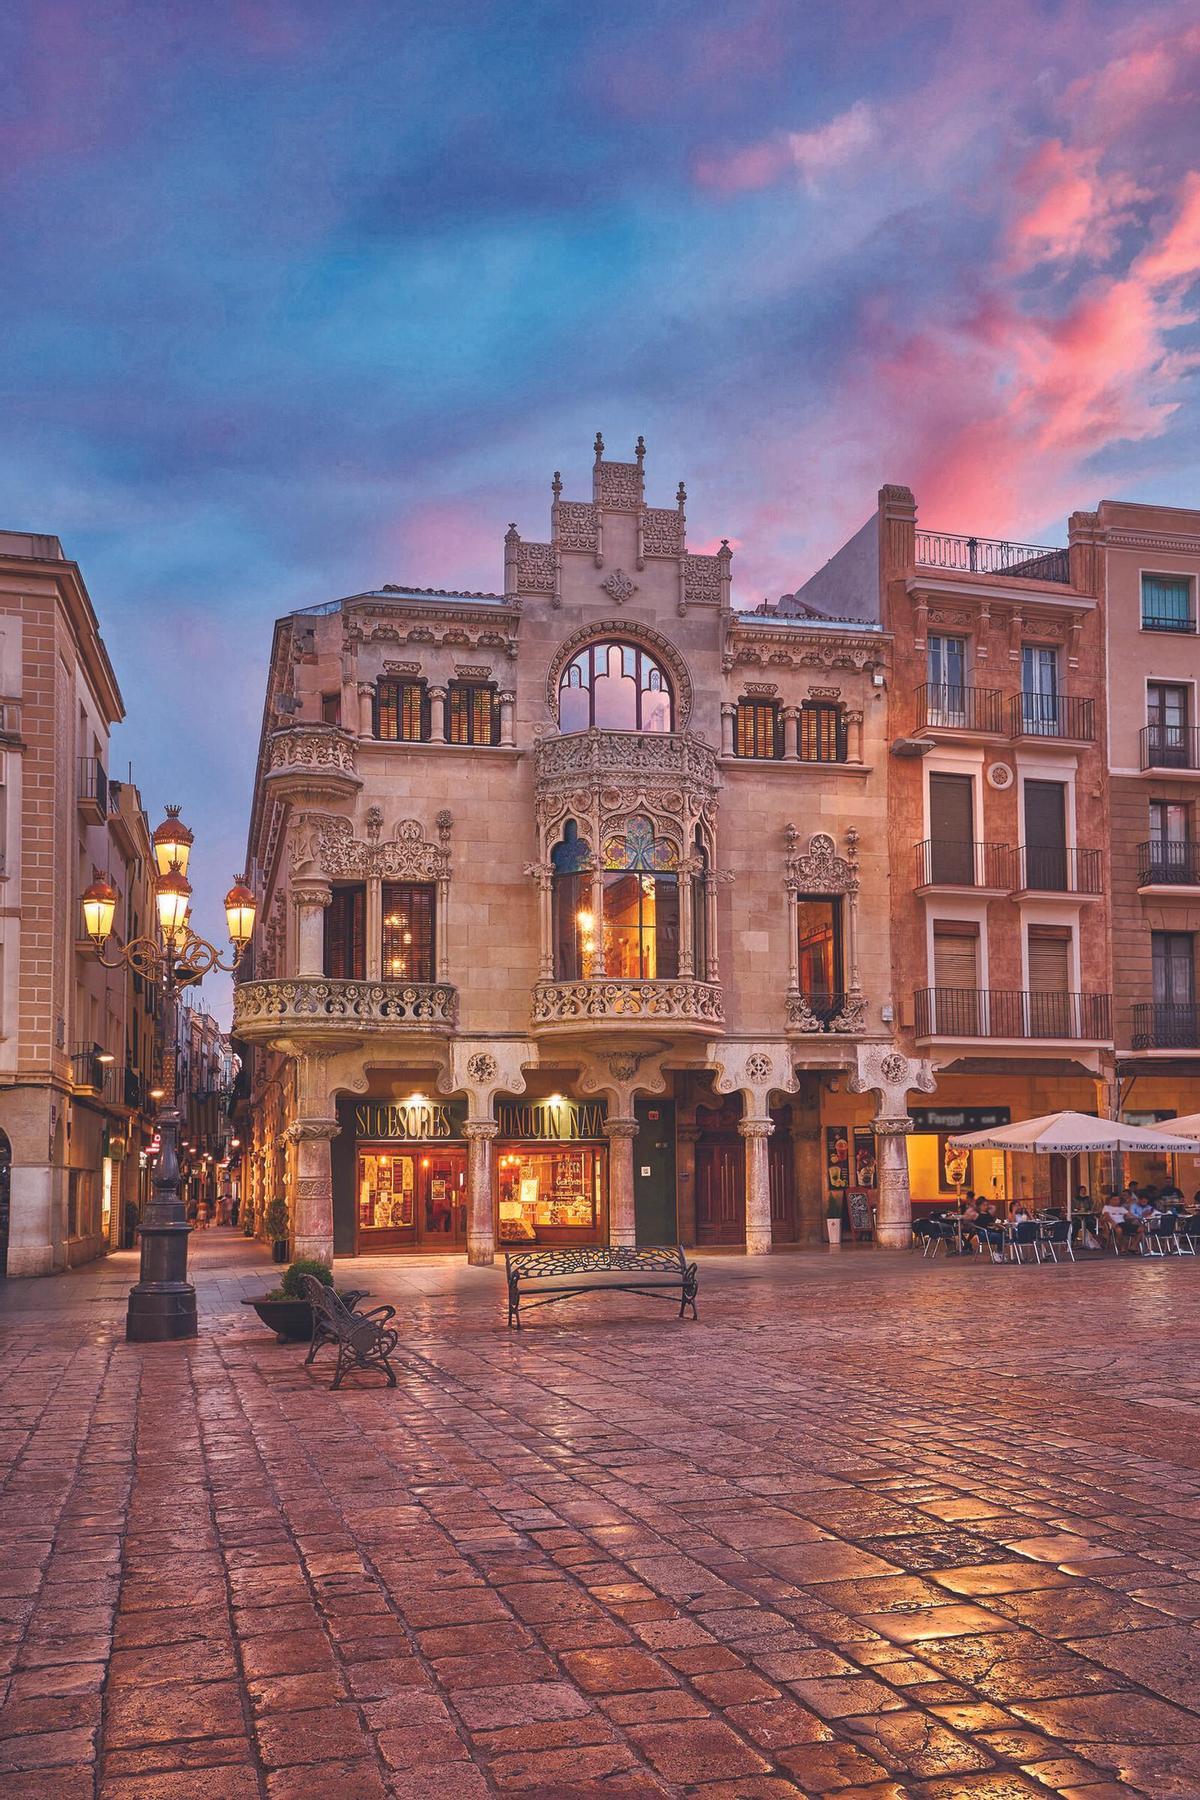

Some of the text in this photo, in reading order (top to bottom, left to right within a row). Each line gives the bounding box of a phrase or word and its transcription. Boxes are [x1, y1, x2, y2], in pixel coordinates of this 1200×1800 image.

[355, 1104, 451, 1137] SUCESORES
[497, 1104, 608, 1138] JOAQUIN NAVA
[1060, 1144, 1083, 1152] FARGGI
